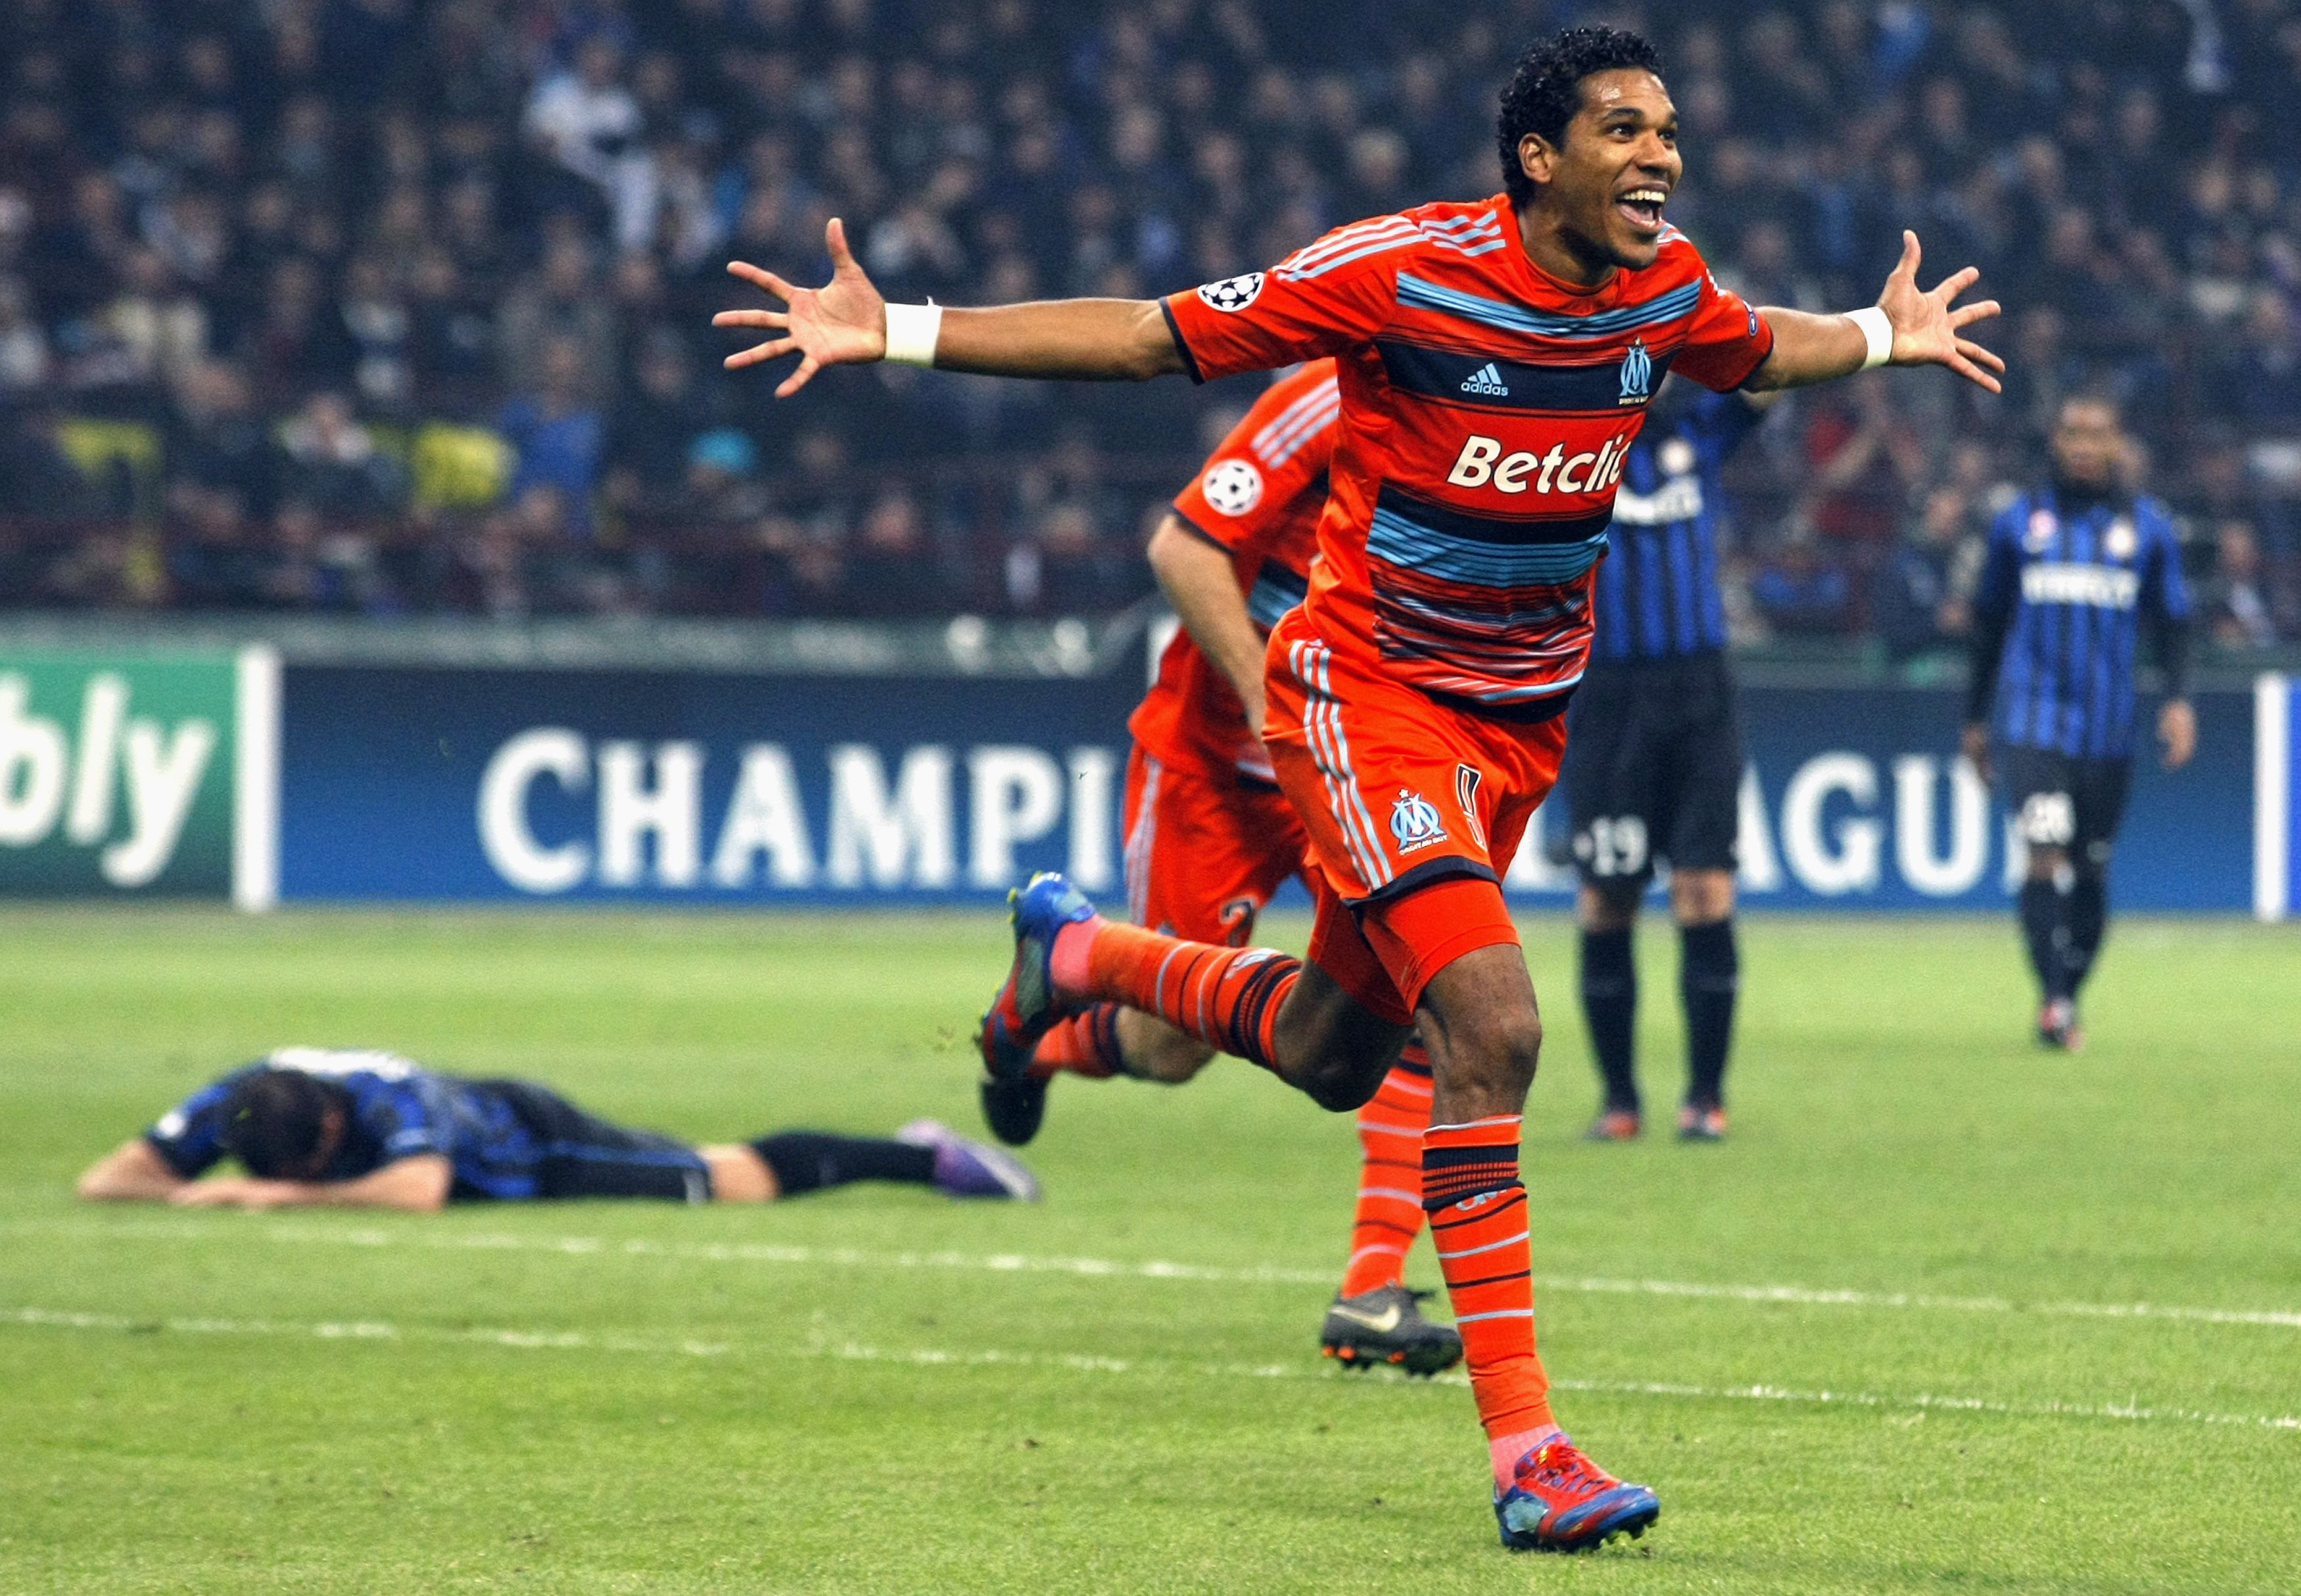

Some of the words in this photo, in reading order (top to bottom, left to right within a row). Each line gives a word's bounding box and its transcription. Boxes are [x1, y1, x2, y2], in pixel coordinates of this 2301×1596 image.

[1460, 381, 1509, 397] adidas
[474, 724, 1119, 895] CHAMPI
[1590, 815, 1648, 877] 19
